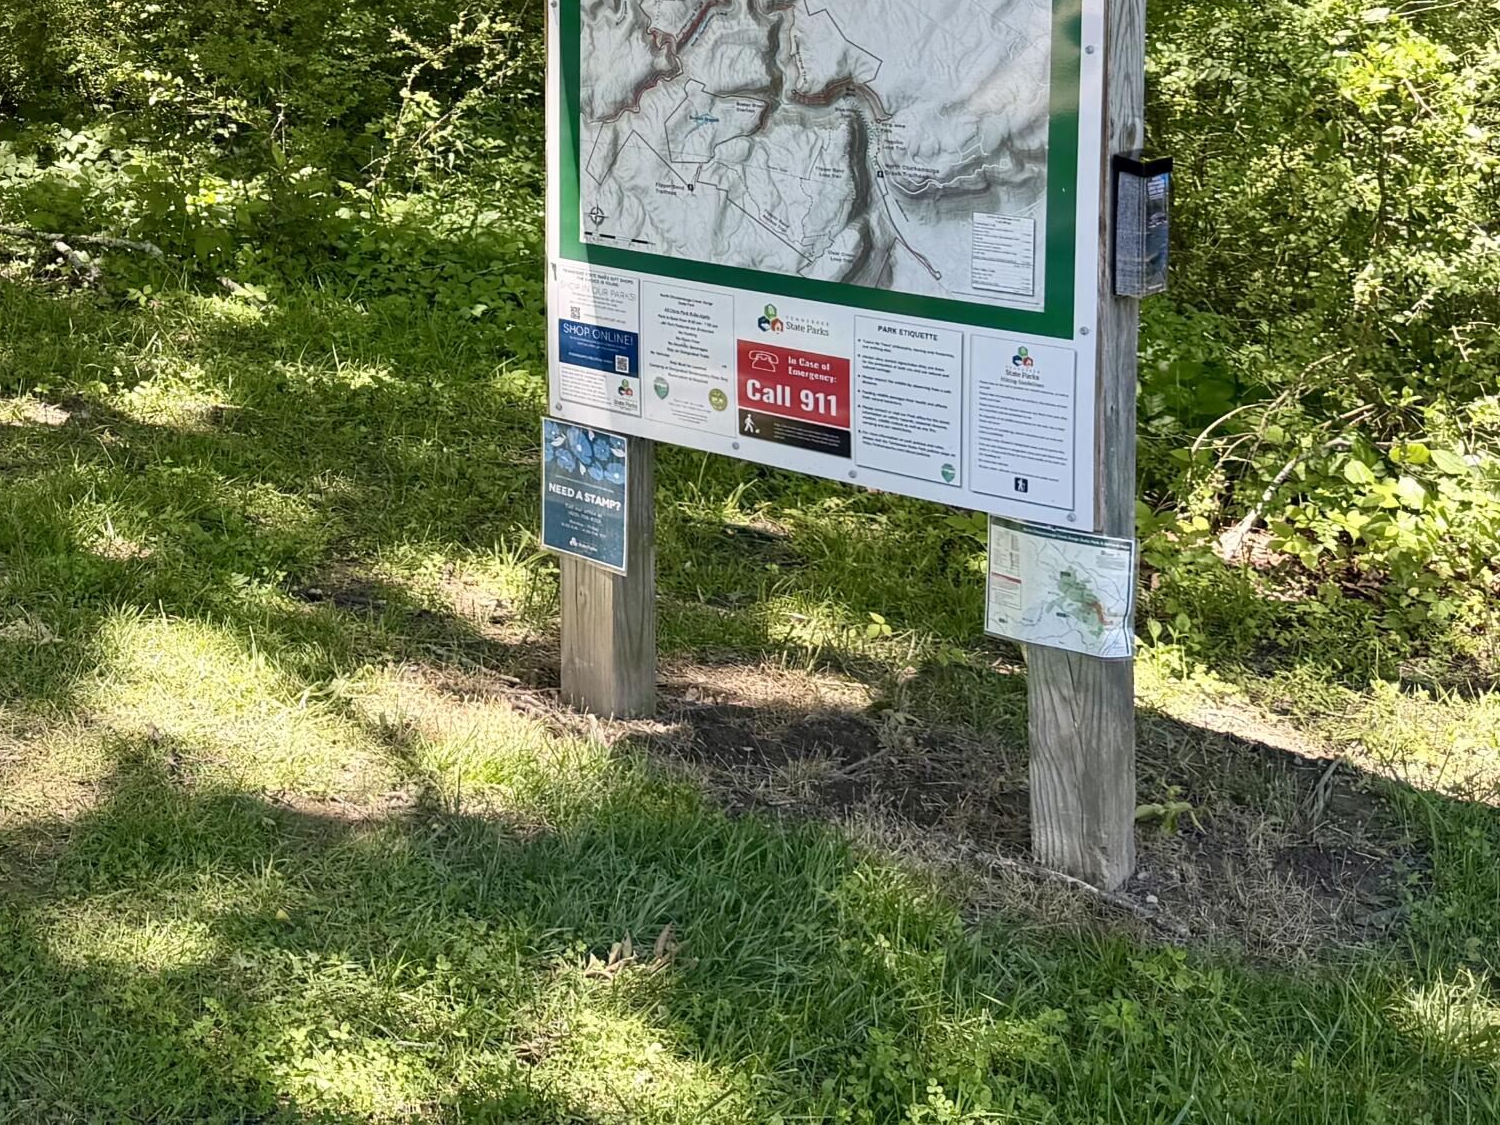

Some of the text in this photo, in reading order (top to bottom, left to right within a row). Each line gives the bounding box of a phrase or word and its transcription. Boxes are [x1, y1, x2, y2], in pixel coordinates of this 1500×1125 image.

[563, 322, 590, 336] SHOP
[592, 329, 634, 346] ONLINE!
[786, 321, 829, 336] State Parks
[878, 325, 938, 341] PARK ETIQUETTE
[788, 355, 830, 371] In Case of
[788, 366, 837, 383] Emergency:
[746, 378, 791, 408] Call
[800, 389, 837, 416] 911
[548, 482, 621, 511] NEED A STAMP?
